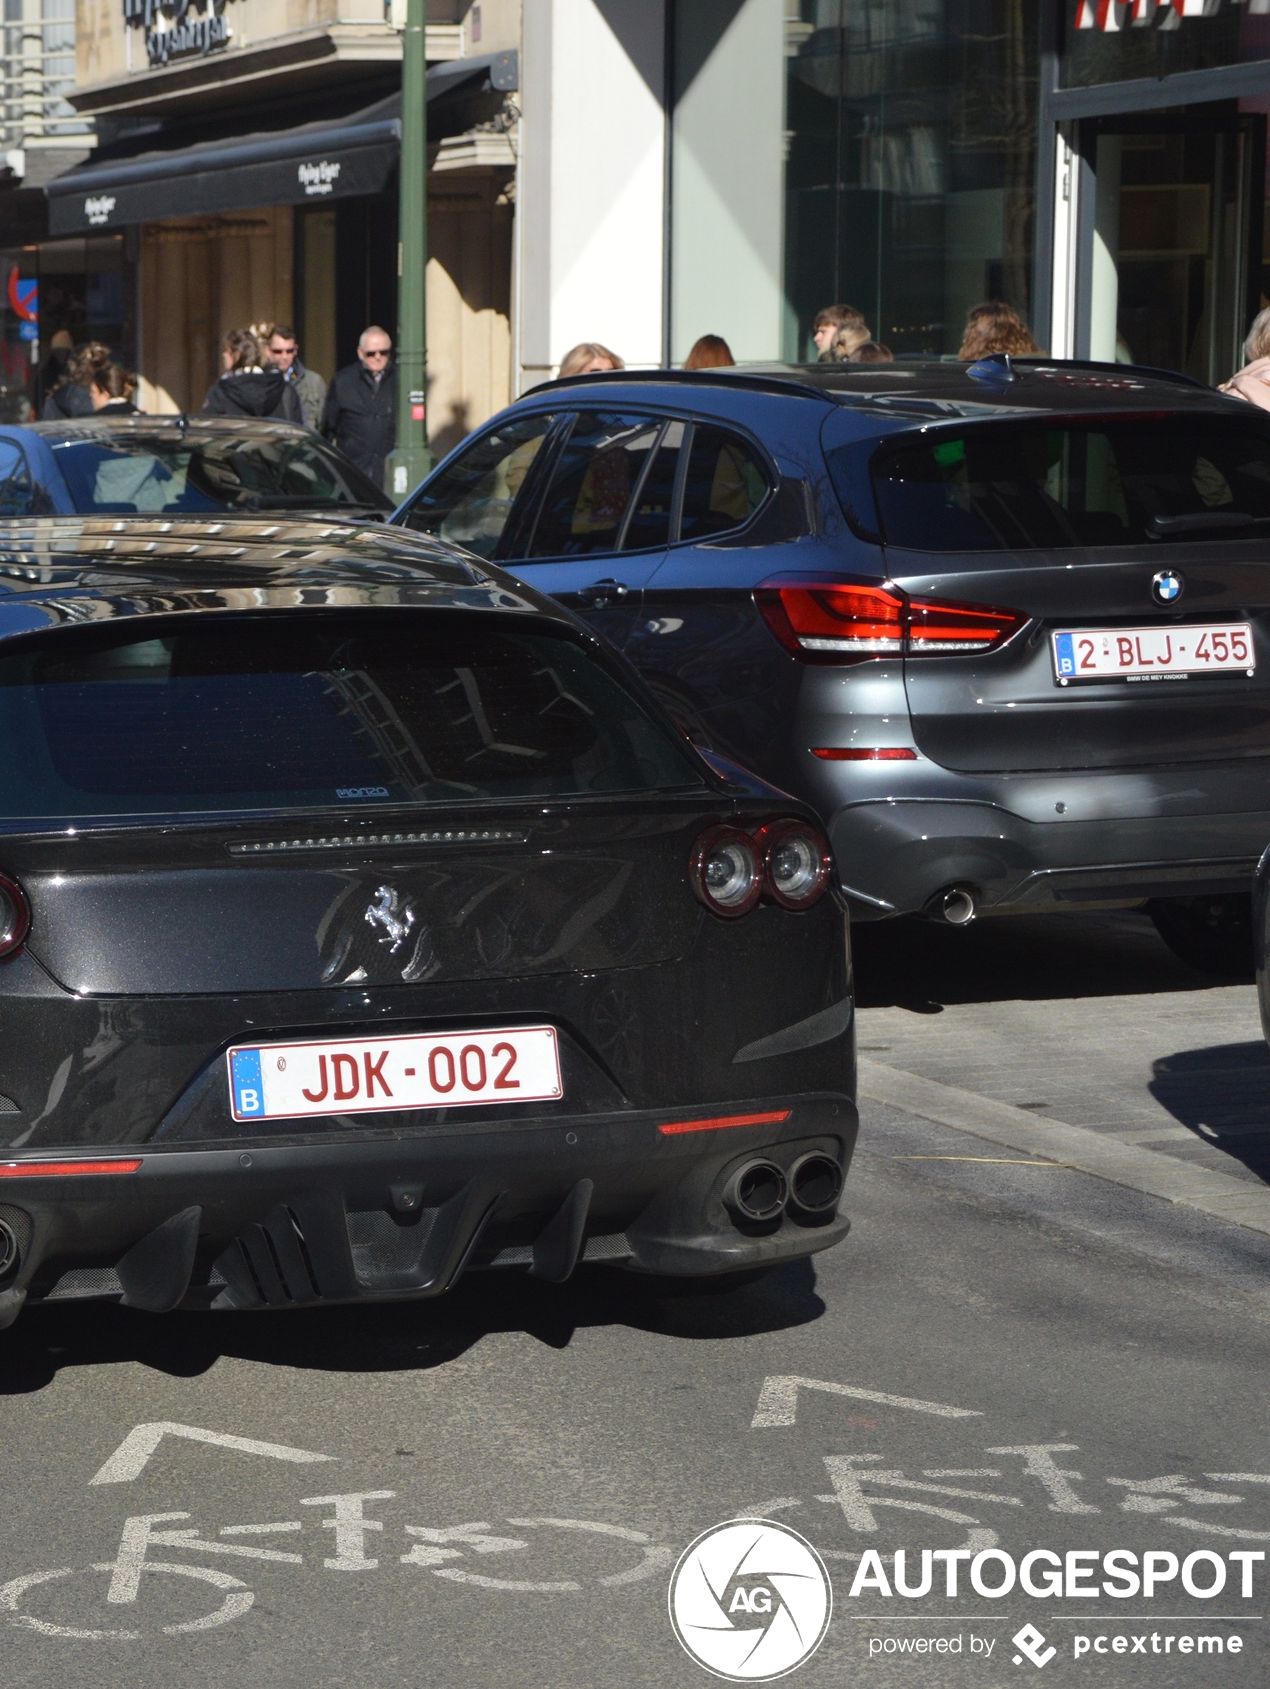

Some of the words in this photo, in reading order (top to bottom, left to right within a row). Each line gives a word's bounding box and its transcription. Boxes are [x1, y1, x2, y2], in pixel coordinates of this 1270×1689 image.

[1061, 658, 1073, 673] B
[1078, 631, 1248, 669] 2-BLJ-455
[240, 1088, 260, 1112] B
[302, 1042, 520, 1103] JDK-002
